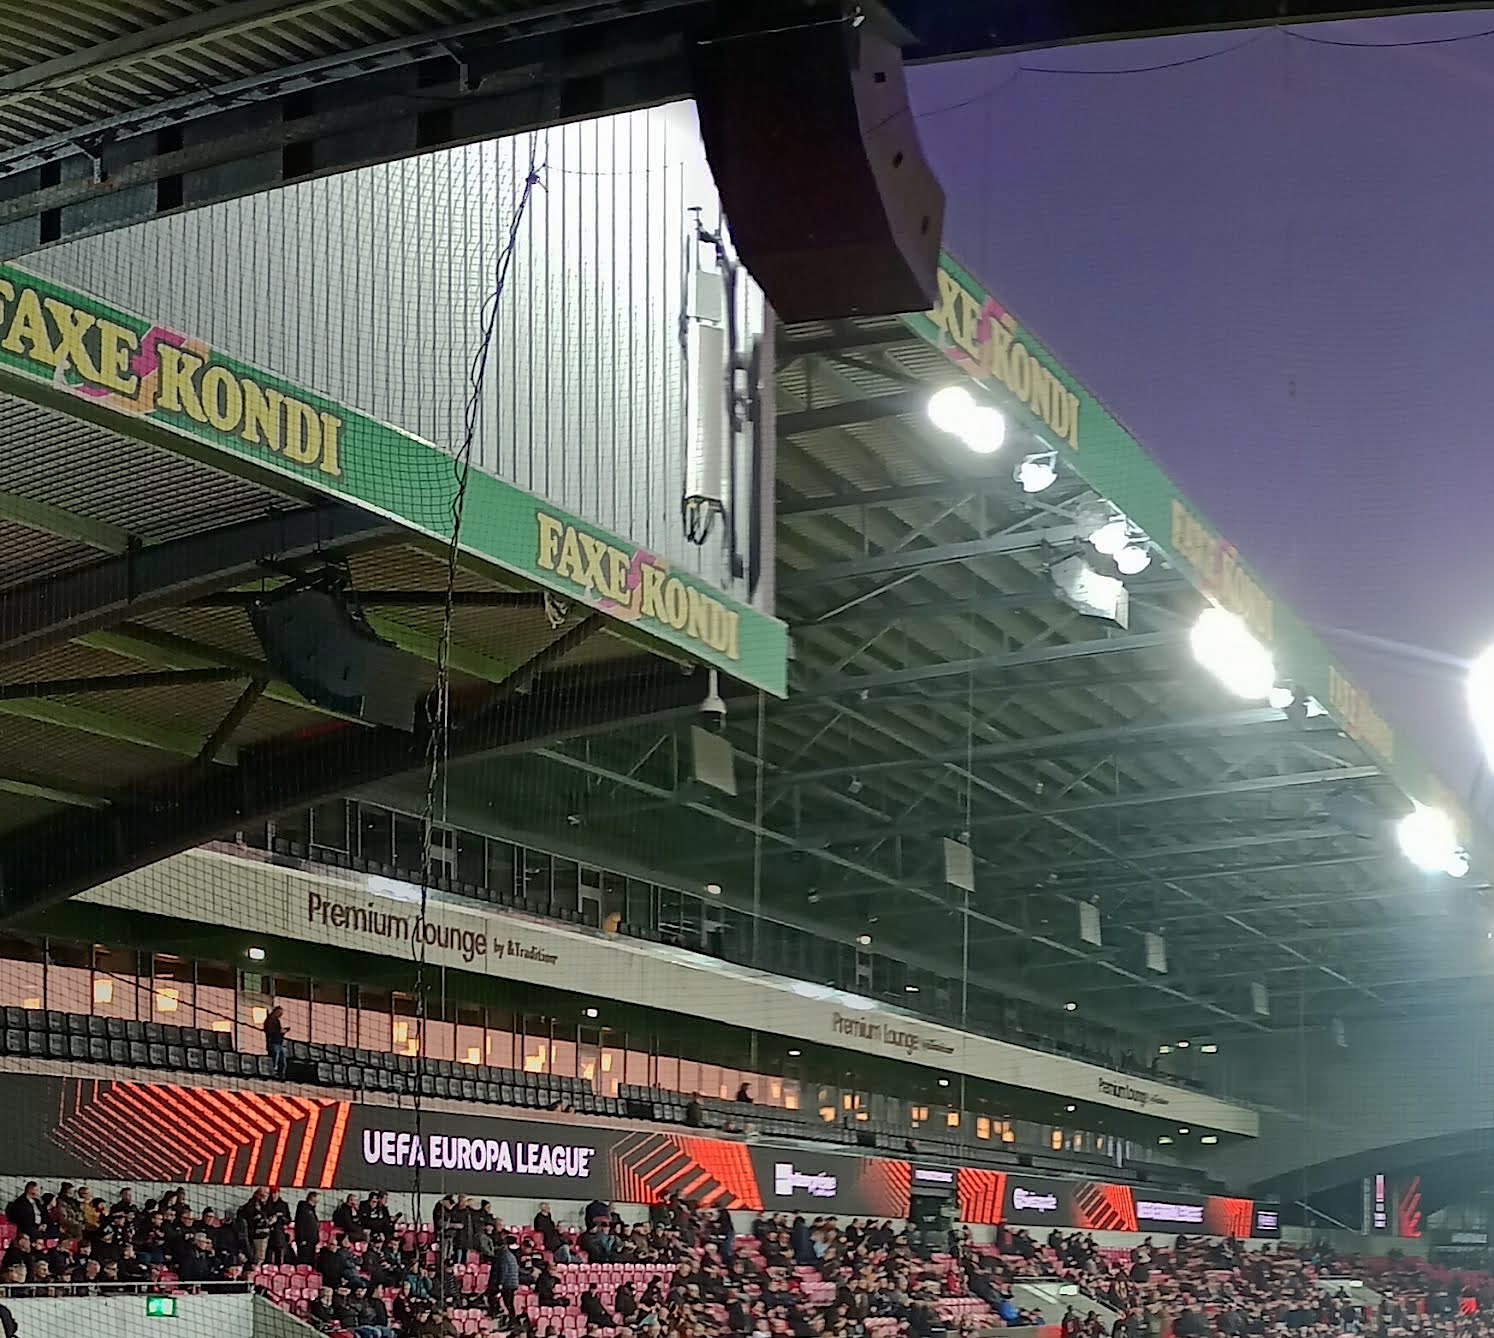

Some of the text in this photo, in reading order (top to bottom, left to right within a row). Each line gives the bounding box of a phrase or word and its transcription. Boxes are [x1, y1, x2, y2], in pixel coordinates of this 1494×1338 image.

[157, 342, 341, 477] KONDI
[926, 267, 1079, 450] XE KONDI
[537, 512, 739, 661] FAXE KONDI
[308, 892, 409, 941] Premium
[415, 916, 486, 962] Lounge
[493, 937, 505, 959] by
[831, 1012, 881, 1041] Premium
[883, 1023, 919, 1056] Lounge
[363, 1129, 590, 1178] UEFA EUROPA LEAGUE
